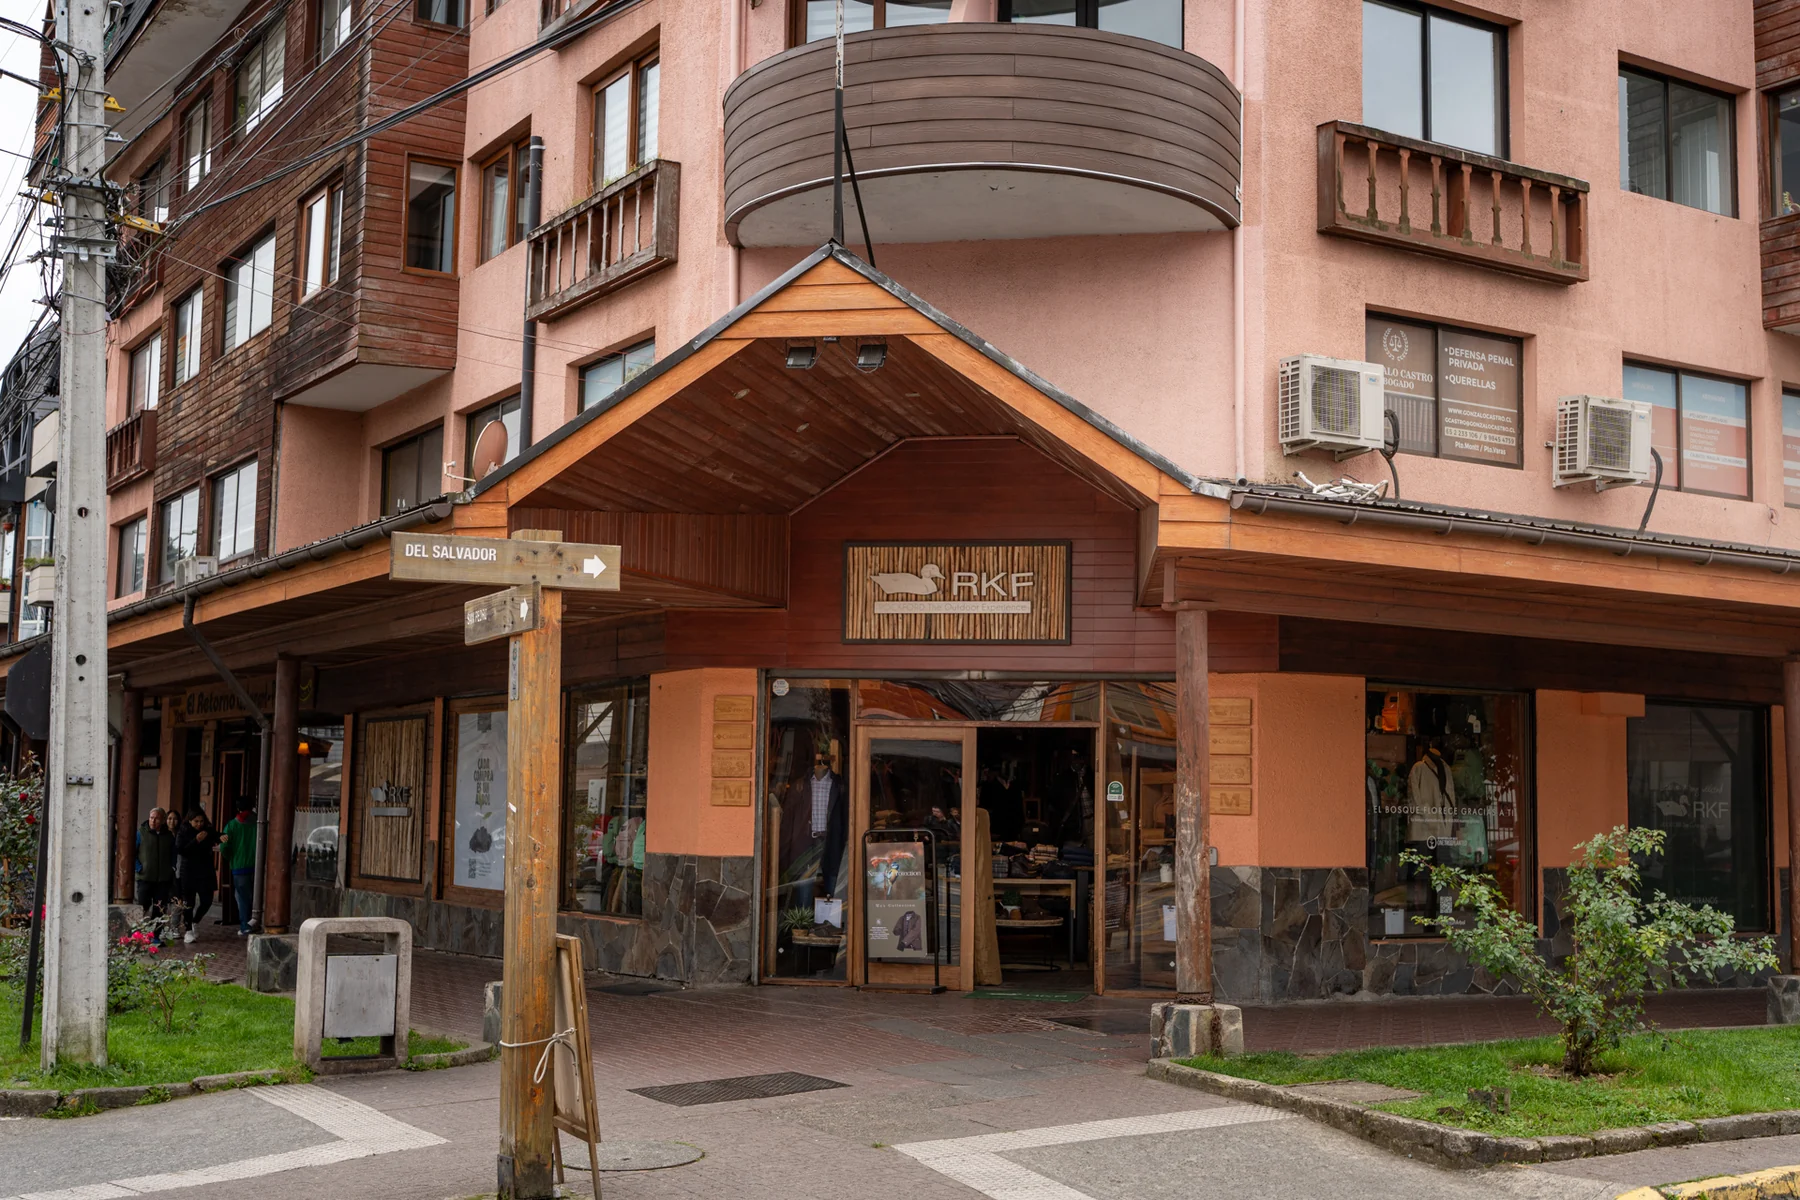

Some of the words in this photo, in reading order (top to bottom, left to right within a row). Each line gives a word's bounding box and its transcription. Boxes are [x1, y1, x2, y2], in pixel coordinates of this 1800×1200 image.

[1448, 346, 1487, 361] DEFENSA
[1488, 353, 1515, 367] PENAL
[1448, 357, 1485, 372] PRIVADA
[1384, 377, 1415, 390] BOGADO
[1400, 369, 1433, 383] CASTRO
[1448, 374, 1496, 390] QUERELLAS
[405, 543, 429, 558] DEL
[432, 545, 497, 561] SALVADOR
[953, 572, 1034, 597] RKF
[928, 603, 942, 611] The
[945, 603, 979, 611] Outdoor
[981, 603, 1027, 612] Experience
[197, 691, 236, 714] Retorno
[724, 785, 743, 799] M
[1220, 793, 1240, 807] M
[1373, 805, 1382, 814] EL
[1385, 805, 1420, 815] BOSQUE
[1423, 806, 1458, 816] FLORECE
[1461, 807, 1496, 817] GRACIAS
[1499, 808, 1505, 817] A
[1693, 801, 1729, 818] RKF
